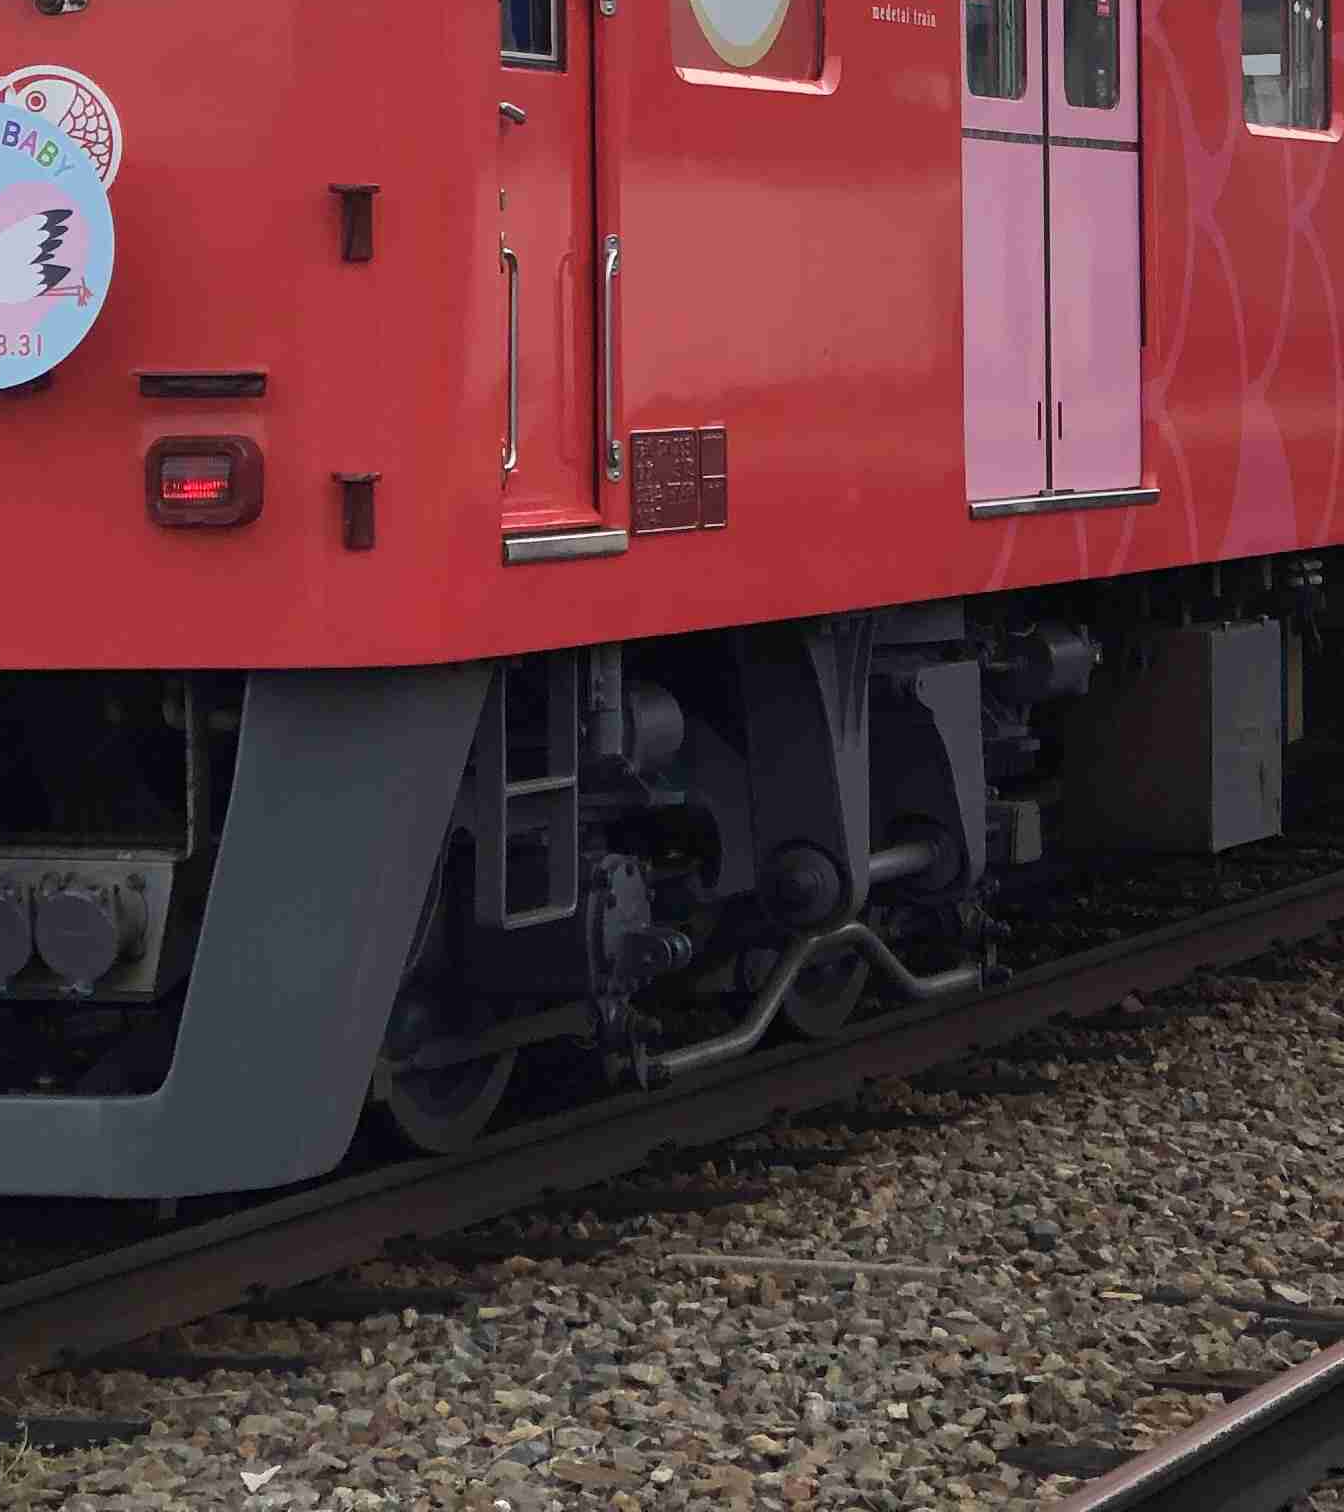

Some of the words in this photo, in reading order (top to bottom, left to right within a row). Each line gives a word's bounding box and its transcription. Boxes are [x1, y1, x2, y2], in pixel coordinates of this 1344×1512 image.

[872, 4, 910, 23] medetai
[914, 9, 937, 28] train
[1, 120, 75, 177] BABY
